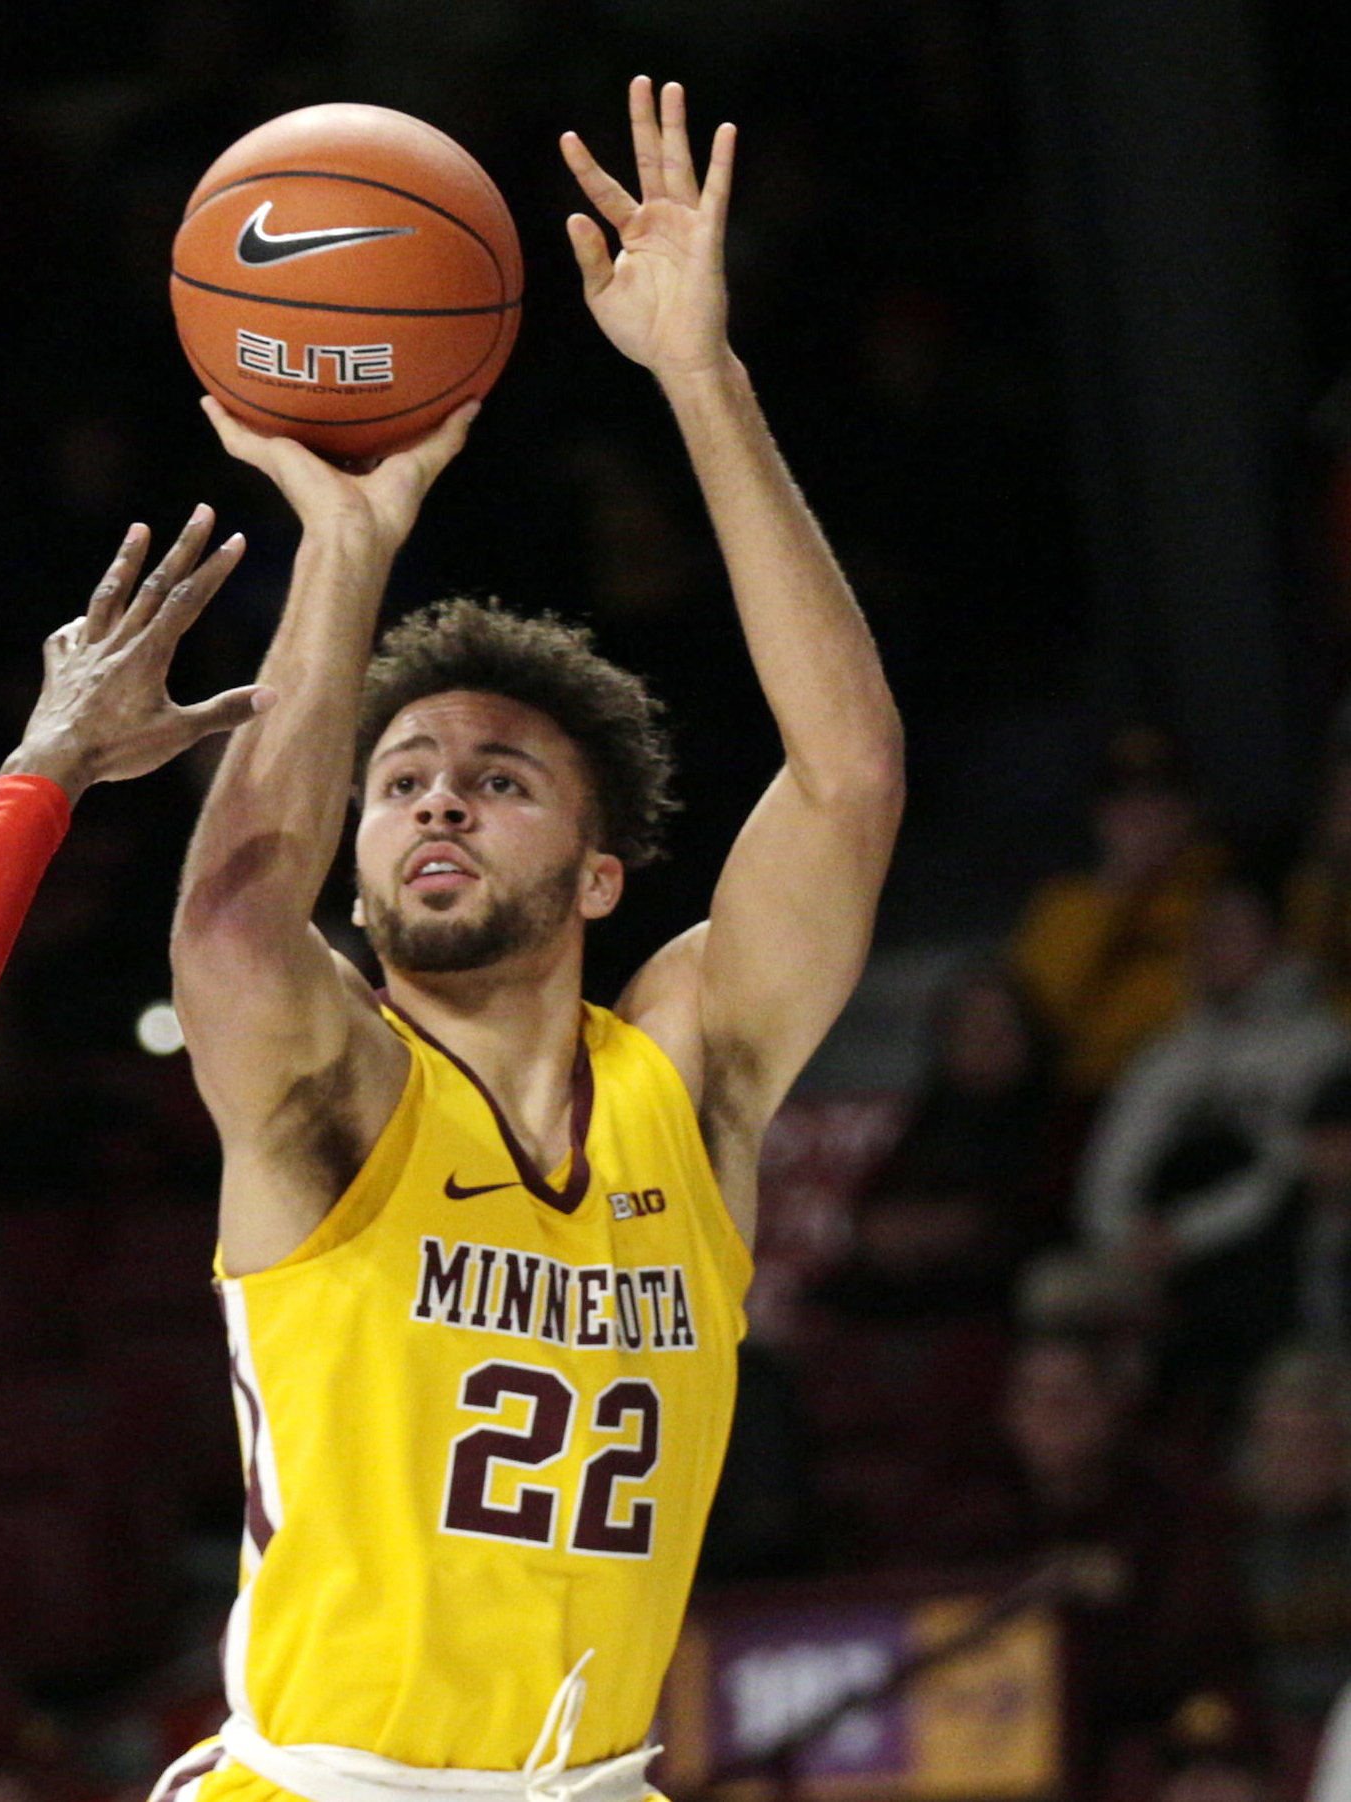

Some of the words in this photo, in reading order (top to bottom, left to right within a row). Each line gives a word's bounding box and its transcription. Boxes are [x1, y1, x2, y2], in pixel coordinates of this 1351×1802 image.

[236, 328, 393, 385] ELITE
[237, 370, 393, 395] CHAMPIONSHIP
[411, 1236, 698, 1352] MINNEOTA
[438, 1357, 662, 1560] 22
